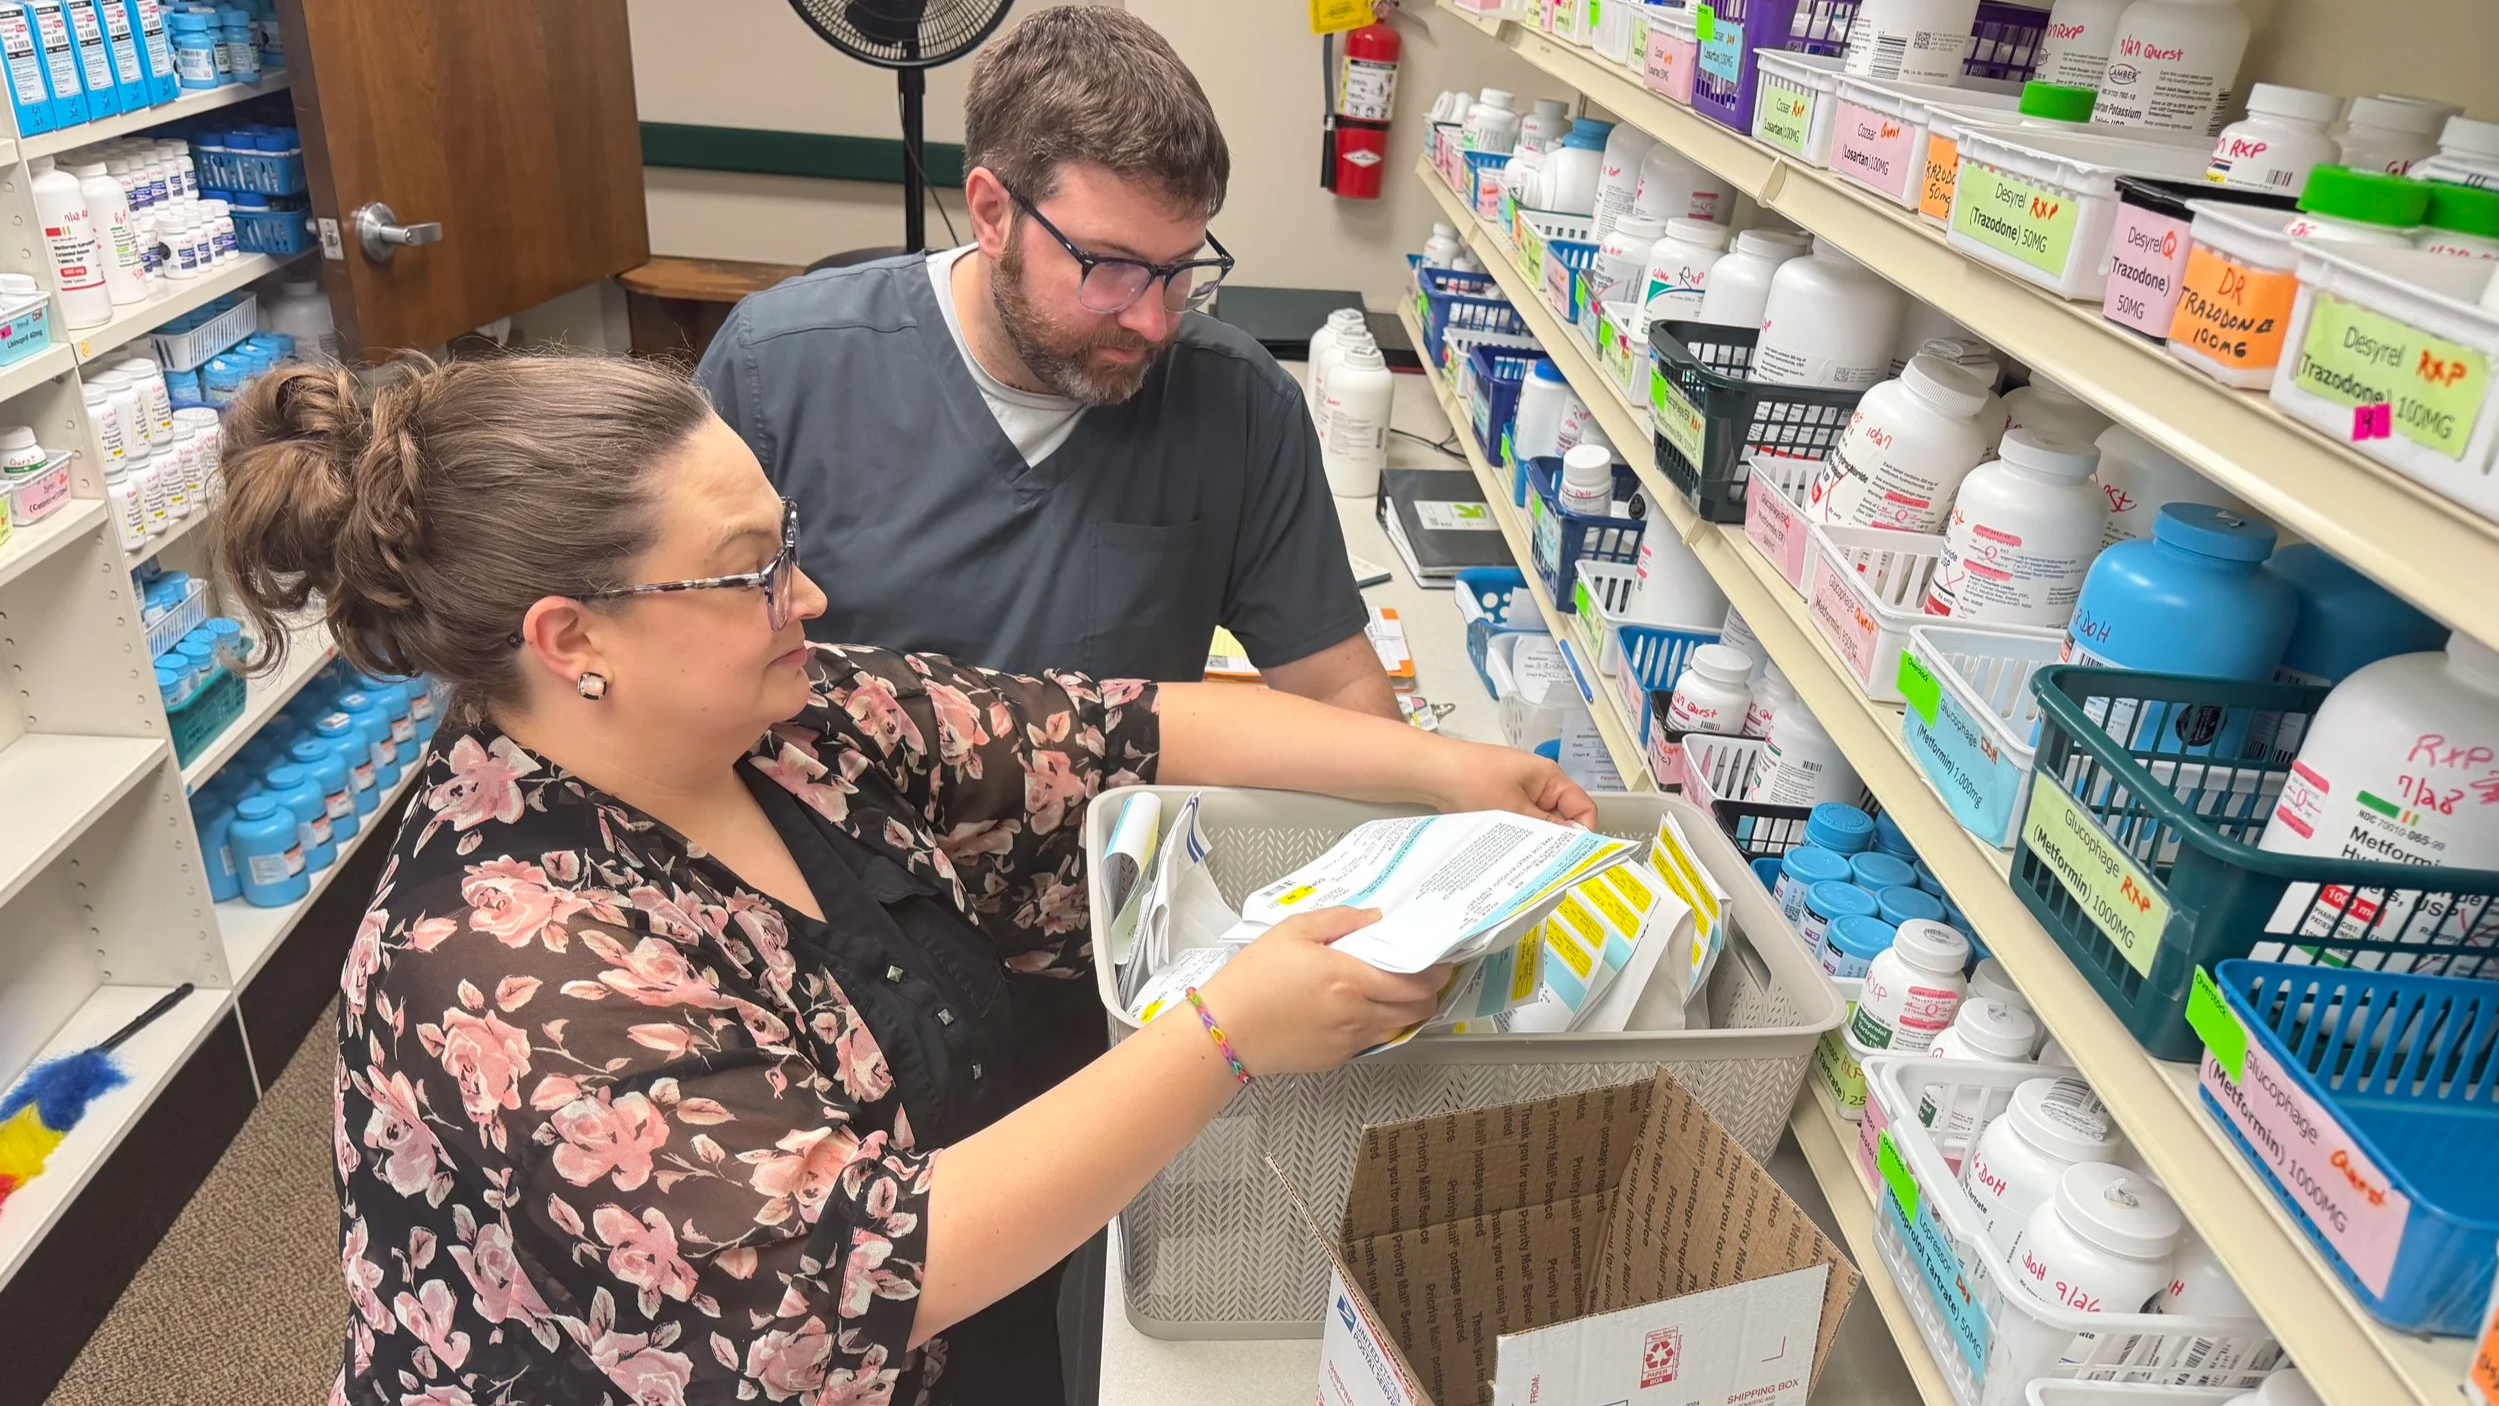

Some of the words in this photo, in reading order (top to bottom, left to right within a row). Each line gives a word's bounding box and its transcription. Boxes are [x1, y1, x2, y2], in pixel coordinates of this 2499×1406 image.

[2144, 43, 2184, 62] Quest
[2108, 64, 2139, 83] CAMBER
[1881, 121, 1901, 139] Quest
[2108, 103, 2142, 120] Potassium
[1858, 122, 1876, 141] Cozaar
[1995, 182, 2027, 209] Desyrel
[1969, 206, 2021, 246] (Trazodone)
[2021, 228, 2048, 254] 50MG
[2127, 226, 2163, 254] Desyrel
[2163, 230, 2177, 260] Q
[2218, 266, 2247, 306] DR
[2116, 294, 2145, 320] 50MG
[2176, 285, 2275, 334] TRAZODONE
[2343, 326, 2407, 368] Desyrel
[2295, 352, 2393, 406] (Trazodone)
[2396, 396, 2455, 439] 100MG
[1828, 573, 1855, 613] Glucophage
[1814, 594, 1842, 641] (Metformin)
[1854, 606, 1876, 635] Quest
[1907, 656, 1929, 684] Overstock
[1687, 700, 1718, 718] Quest
[1940, 698, 1978, 748] Glucophage
[1916, 723, 1955, 776] (Metformin)
[1953, 767, 1983, 810] 1,000mg
[2398, 774, 2465, 816] 7/28
[2357, 808, 2378, 825] NDC
[2064, 807, 2120, 879] Glucophage
[2033, 823, 2092, 903] (Metformin)
[2092, 894, 2136, 950] 1000MG
[2195, 972, 2227, 1019] Overstock
[1858, 1009, 1888, 1038] Metoprolol
[1858, 1021, 1880, 1042] Tartrate
[1818, 1055, 1846, 1102] Tartrate)
[1849, 1094, 1866, 1107] 25
[2244, 1049, 2320, 1146] Glucophage
[1519, 1105, 1533, 1142] Thank
[1655, 1091, 1673, 1154] Priority
[1388, 1129, 1399, 1162] Thank
[1416, 1131, 1430, 1173] Priority
[1519, 1142, 1531, 1162] you
[1634, 1143, 1646, 1166] for
[1882, 1136, 1905, 1174] Overstock
[2208, 1057, 2286, 1167] (Metformin)
[2287, 1159, 2348, 1234] 1000MG
[1387, 1162, 1399, 1183] you
[1519, 1166, 1531, 1181] for
[1569, 1155, 1584, 1196] Priority
[1626, 1167, 1640, 1207] using
[1390, 1186, 1401, 1203] for
[1444, 1179, 1459, 1222] Priority
[1519, 1182, 1531, 1208] using
[1683, 1167, 1701, 1229] postage
[1966, 1185, 1988, 1214] Tartrate
[1389, 1205, 1401, 1233] using
[1418, 1203, 1430, 1245] Service
[1490, 1208, 1503, 1243] Thank
[1517, 1208, 1532, 1251] Priority
[1642, 1193, 1657, 1248] Service
[1363, 1231, 1378, 1270] Thank
[1391, 1234, 1408, 1277] Priority
[1491, 1243, 1504, 1266] you
[1569, 1225, 1583, 1266] postage
[1676, 1229, 1689, 1296] required
[1919, 1213, 1952, 1275] Lopressor
[1366, 1271, 1379, 1292] you
[1447, 1250, 1462, 1296] postage
[1494, 1266, 1505, 1284] for
[1570, 1266, 1585, 1317] required
[1495, 1285, 1508, 1315] using
[1522, 1283, 1533, 1325] Service
[1924, 1256, 1960, 1322] Tartrate)
[1960, 1317, 1983, 1360] 50MG
[2055, 1280, 2102, 1313] 9/26
[1401, 1307, 1413, 1350] Service
[1453, 1296, 1467, 1344] required
[1353, 1332, 1377, 1376] POSTAL
[1375, 1373, 1400, 1406] SERVIC
[1356, 1321, 1381, 1364] UNITED
[1378, 1362, 1402, 1404] STATES
[1646, 1368, 1668, 1379] PAPER
[1649, 1376, 1664, 1385] BOX
[1530, 1374, 1541, 1404] FROM:
[1727, 1384, 1776, 1405] SHIPPING
[1777, 1378, 1800, 1391] BOX
